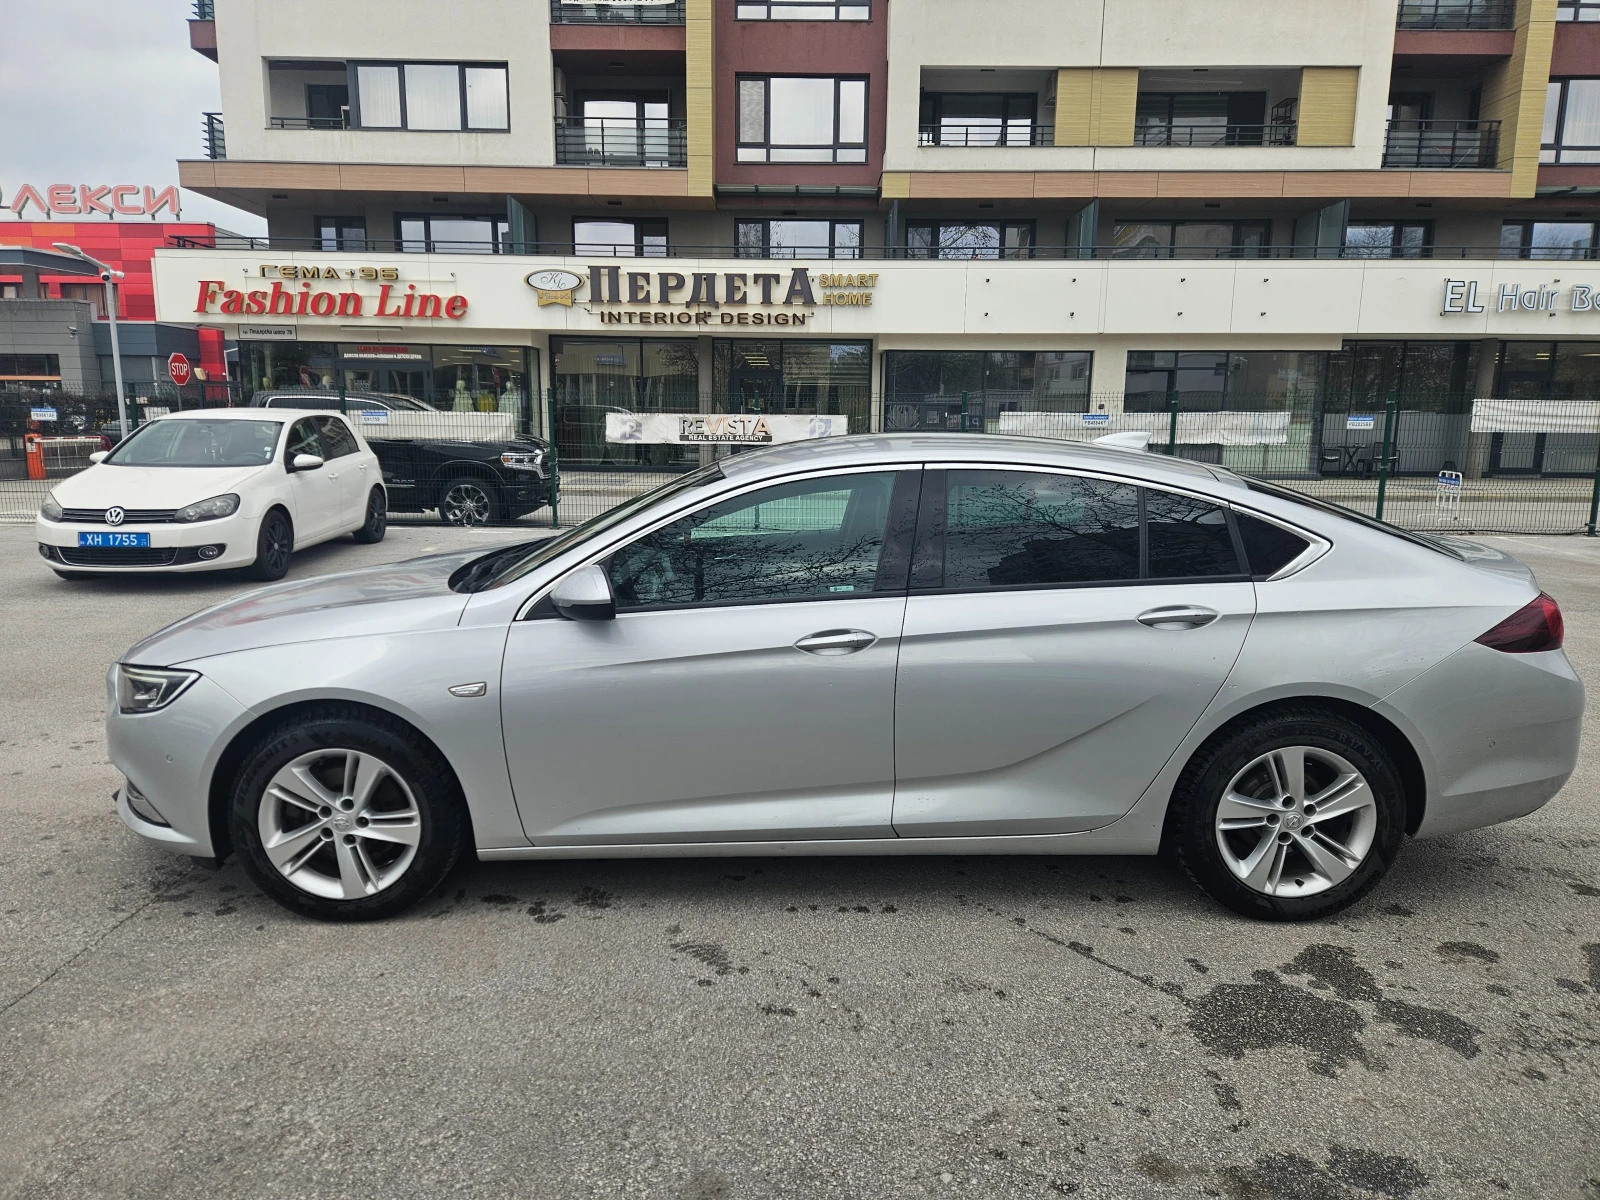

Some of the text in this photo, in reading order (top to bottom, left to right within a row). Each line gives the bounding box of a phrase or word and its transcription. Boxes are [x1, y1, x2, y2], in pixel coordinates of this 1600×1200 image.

[588, 265, 817, 309] ПЕРДЕТА
[819, 273, 880, 287] SMART
[193, 280, 468, 319] Fashion Line
[822, 291, 873, 306] HOME
[1443, 280, 1484, 313] EL
[1496, 283, 1559, 313] Hair
[600, 311, 806, 325] INTERIOR DESIGN
[171, 362, 188, 376] STOP
[679, 416, 772, 434] REVISTA
[86, 534, 137, 546] XH 1755
